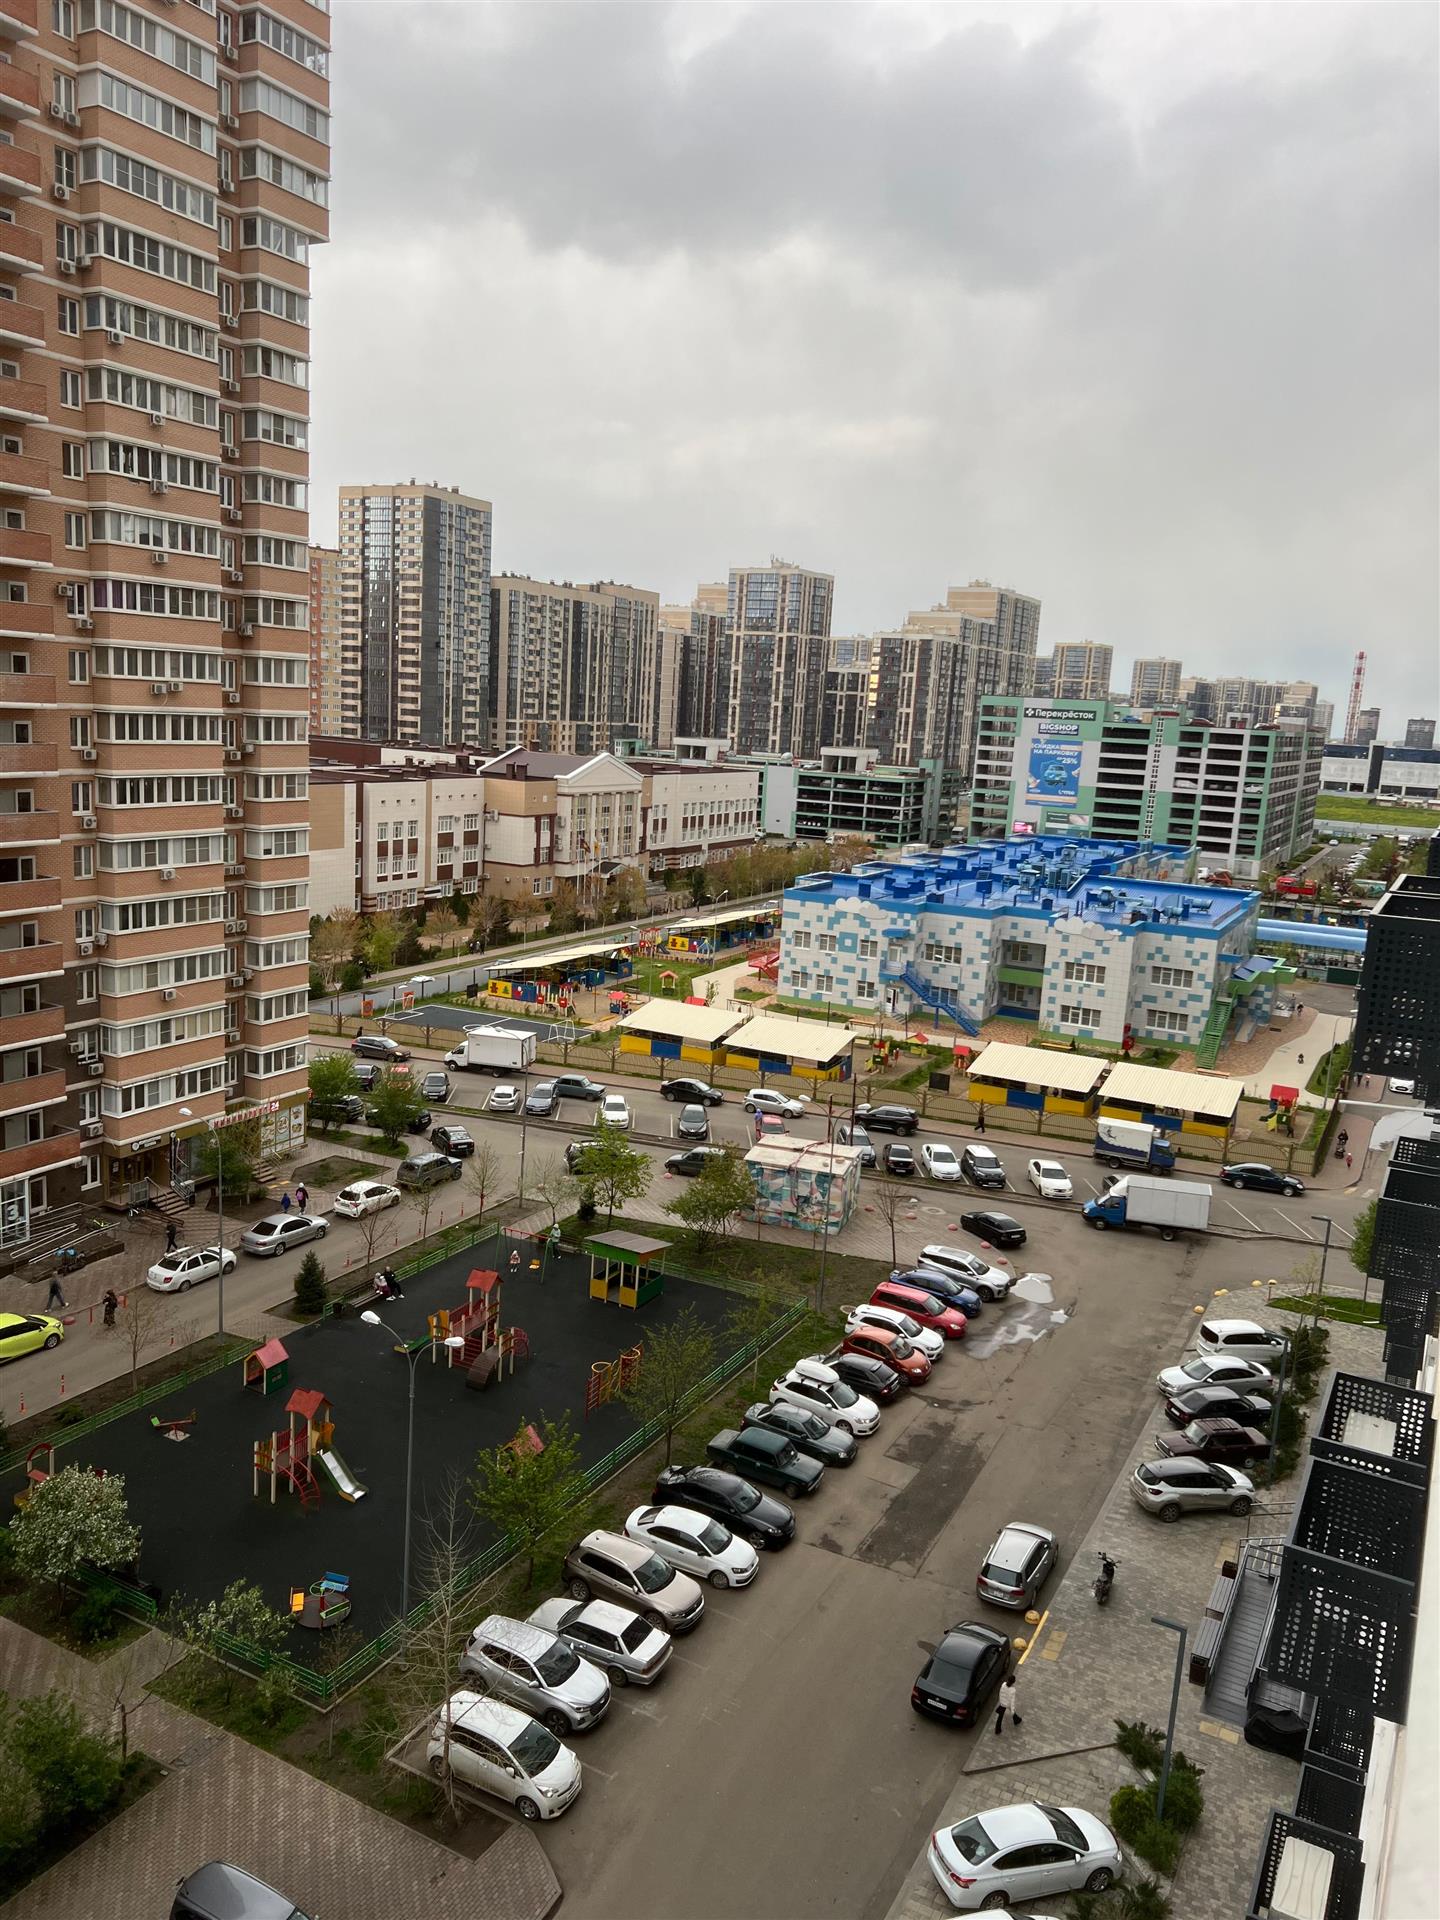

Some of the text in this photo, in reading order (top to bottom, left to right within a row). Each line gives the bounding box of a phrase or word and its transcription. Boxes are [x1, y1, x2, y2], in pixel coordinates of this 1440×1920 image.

[1035, 708, 1094, 719] Перекрёсток
[1040, 723, 1078, 731] BIGSHOP
[271, 1101, 279, 1112] 24
